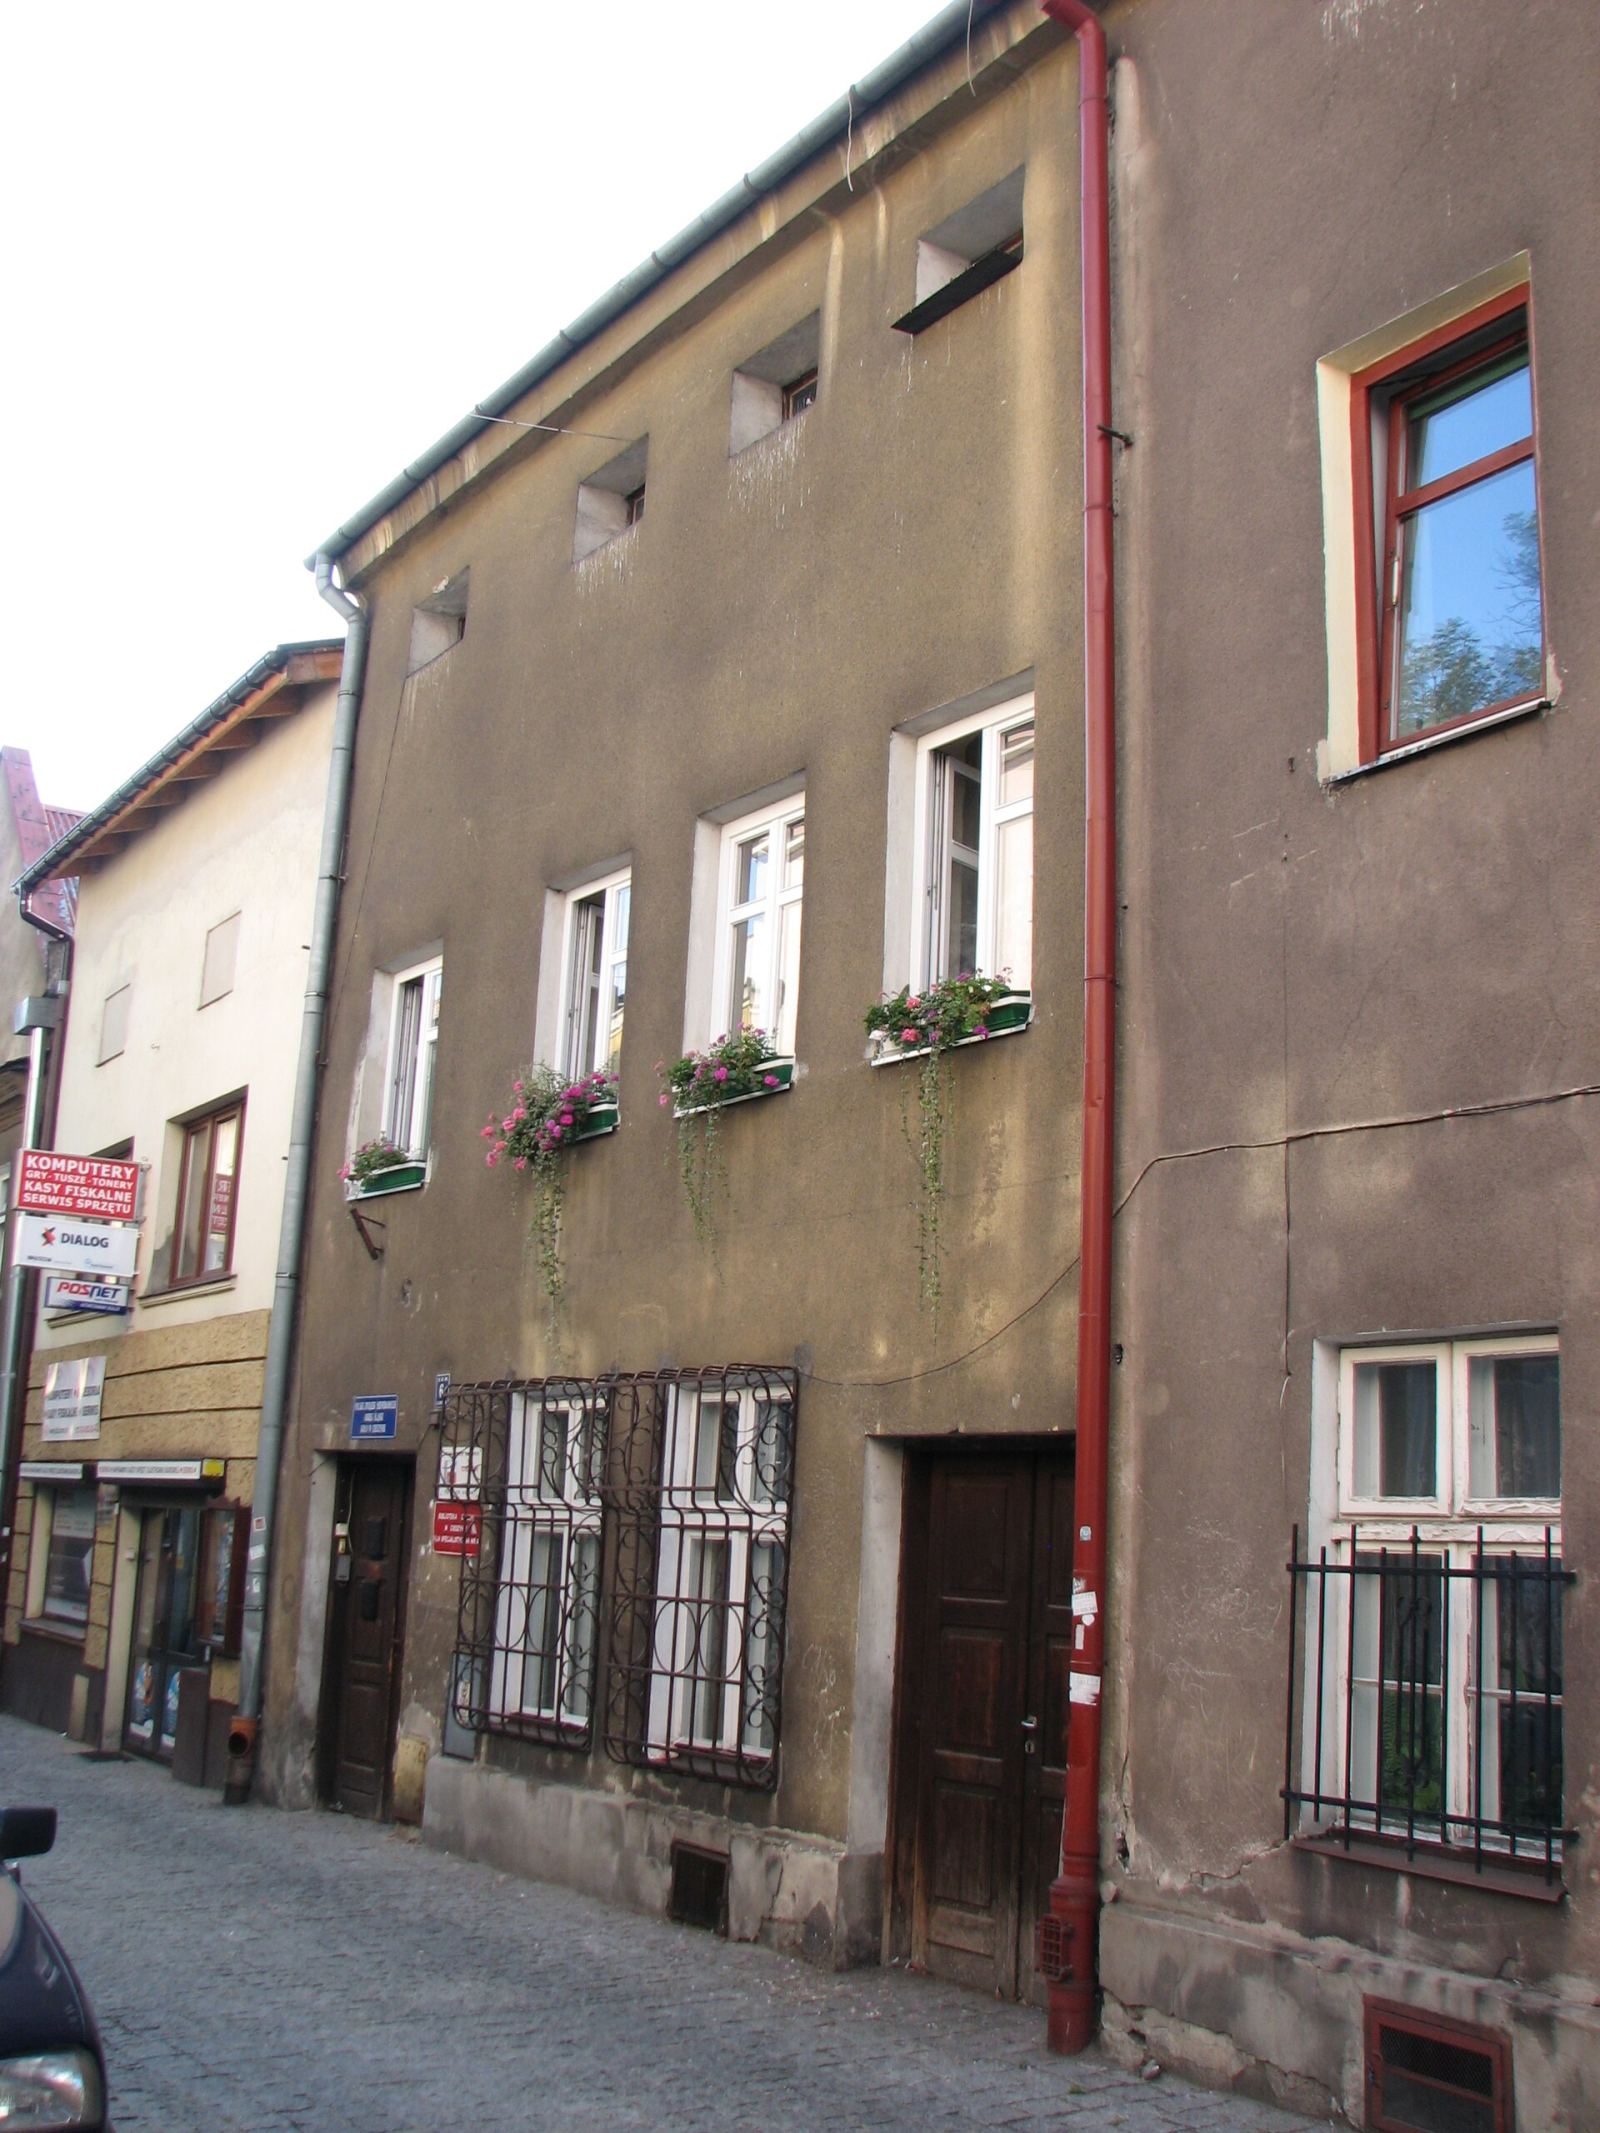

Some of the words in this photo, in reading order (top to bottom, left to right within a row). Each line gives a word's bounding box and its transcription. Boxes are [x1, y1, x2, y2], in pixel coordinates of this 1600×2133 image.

[27, 1156, 135, 1179] KOMPUTERY
[26, 1170, 47, 1180] GRY
[54, 1173, 85, 1184] TUSZE
[93, 1178, 133, 1190] TONERY
[25, 1181, 60, 1194] KASY
[65, 1185, 132, 1203] FISKALNE
[23, 1193, 73, 1207] SERWIS
[76, 1199, 131, 1214] SPRZĘTU
[61, 1233, 109, 1248] DIALOG
[57, 1282, 122, 1299] POSNET
